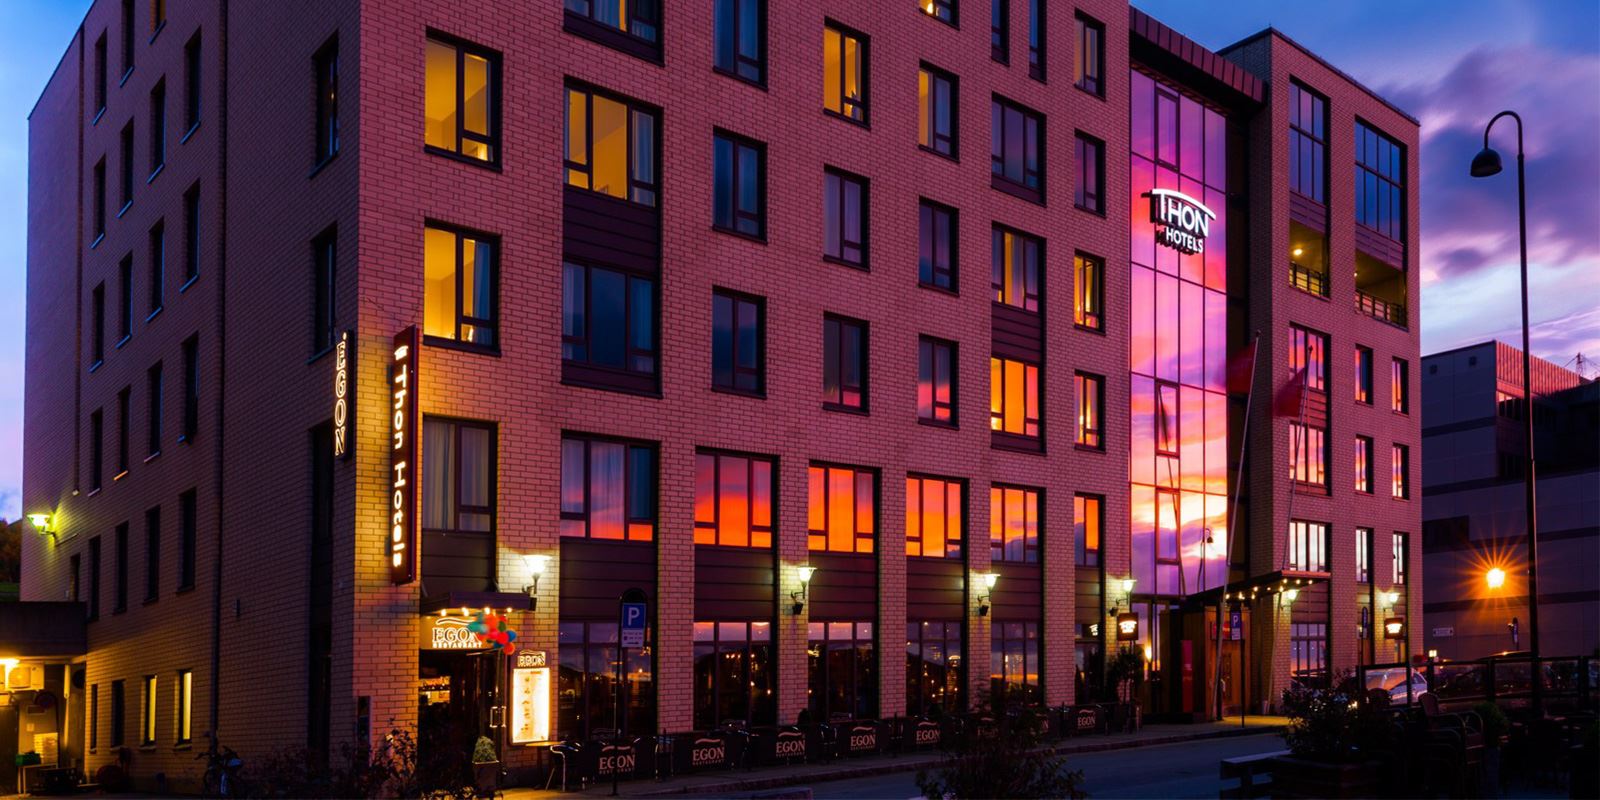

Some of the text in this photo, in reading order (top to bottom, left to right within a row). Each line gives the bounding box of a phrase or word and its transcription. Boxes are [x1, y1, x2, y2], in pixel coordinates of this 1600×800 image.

[1151, 188, 1216, 237] THON
[1166, 226, 1204, 253] HOTELS
[334, 341, 346, 456] EGON
[392, 363, 407, 567] Thon Hotels
[628, 607, 640, 627] P
[776, 740, 806, 753] EGON
[850, 735, 876, 747] EGON
[692, 748, 725, 761] EGON
